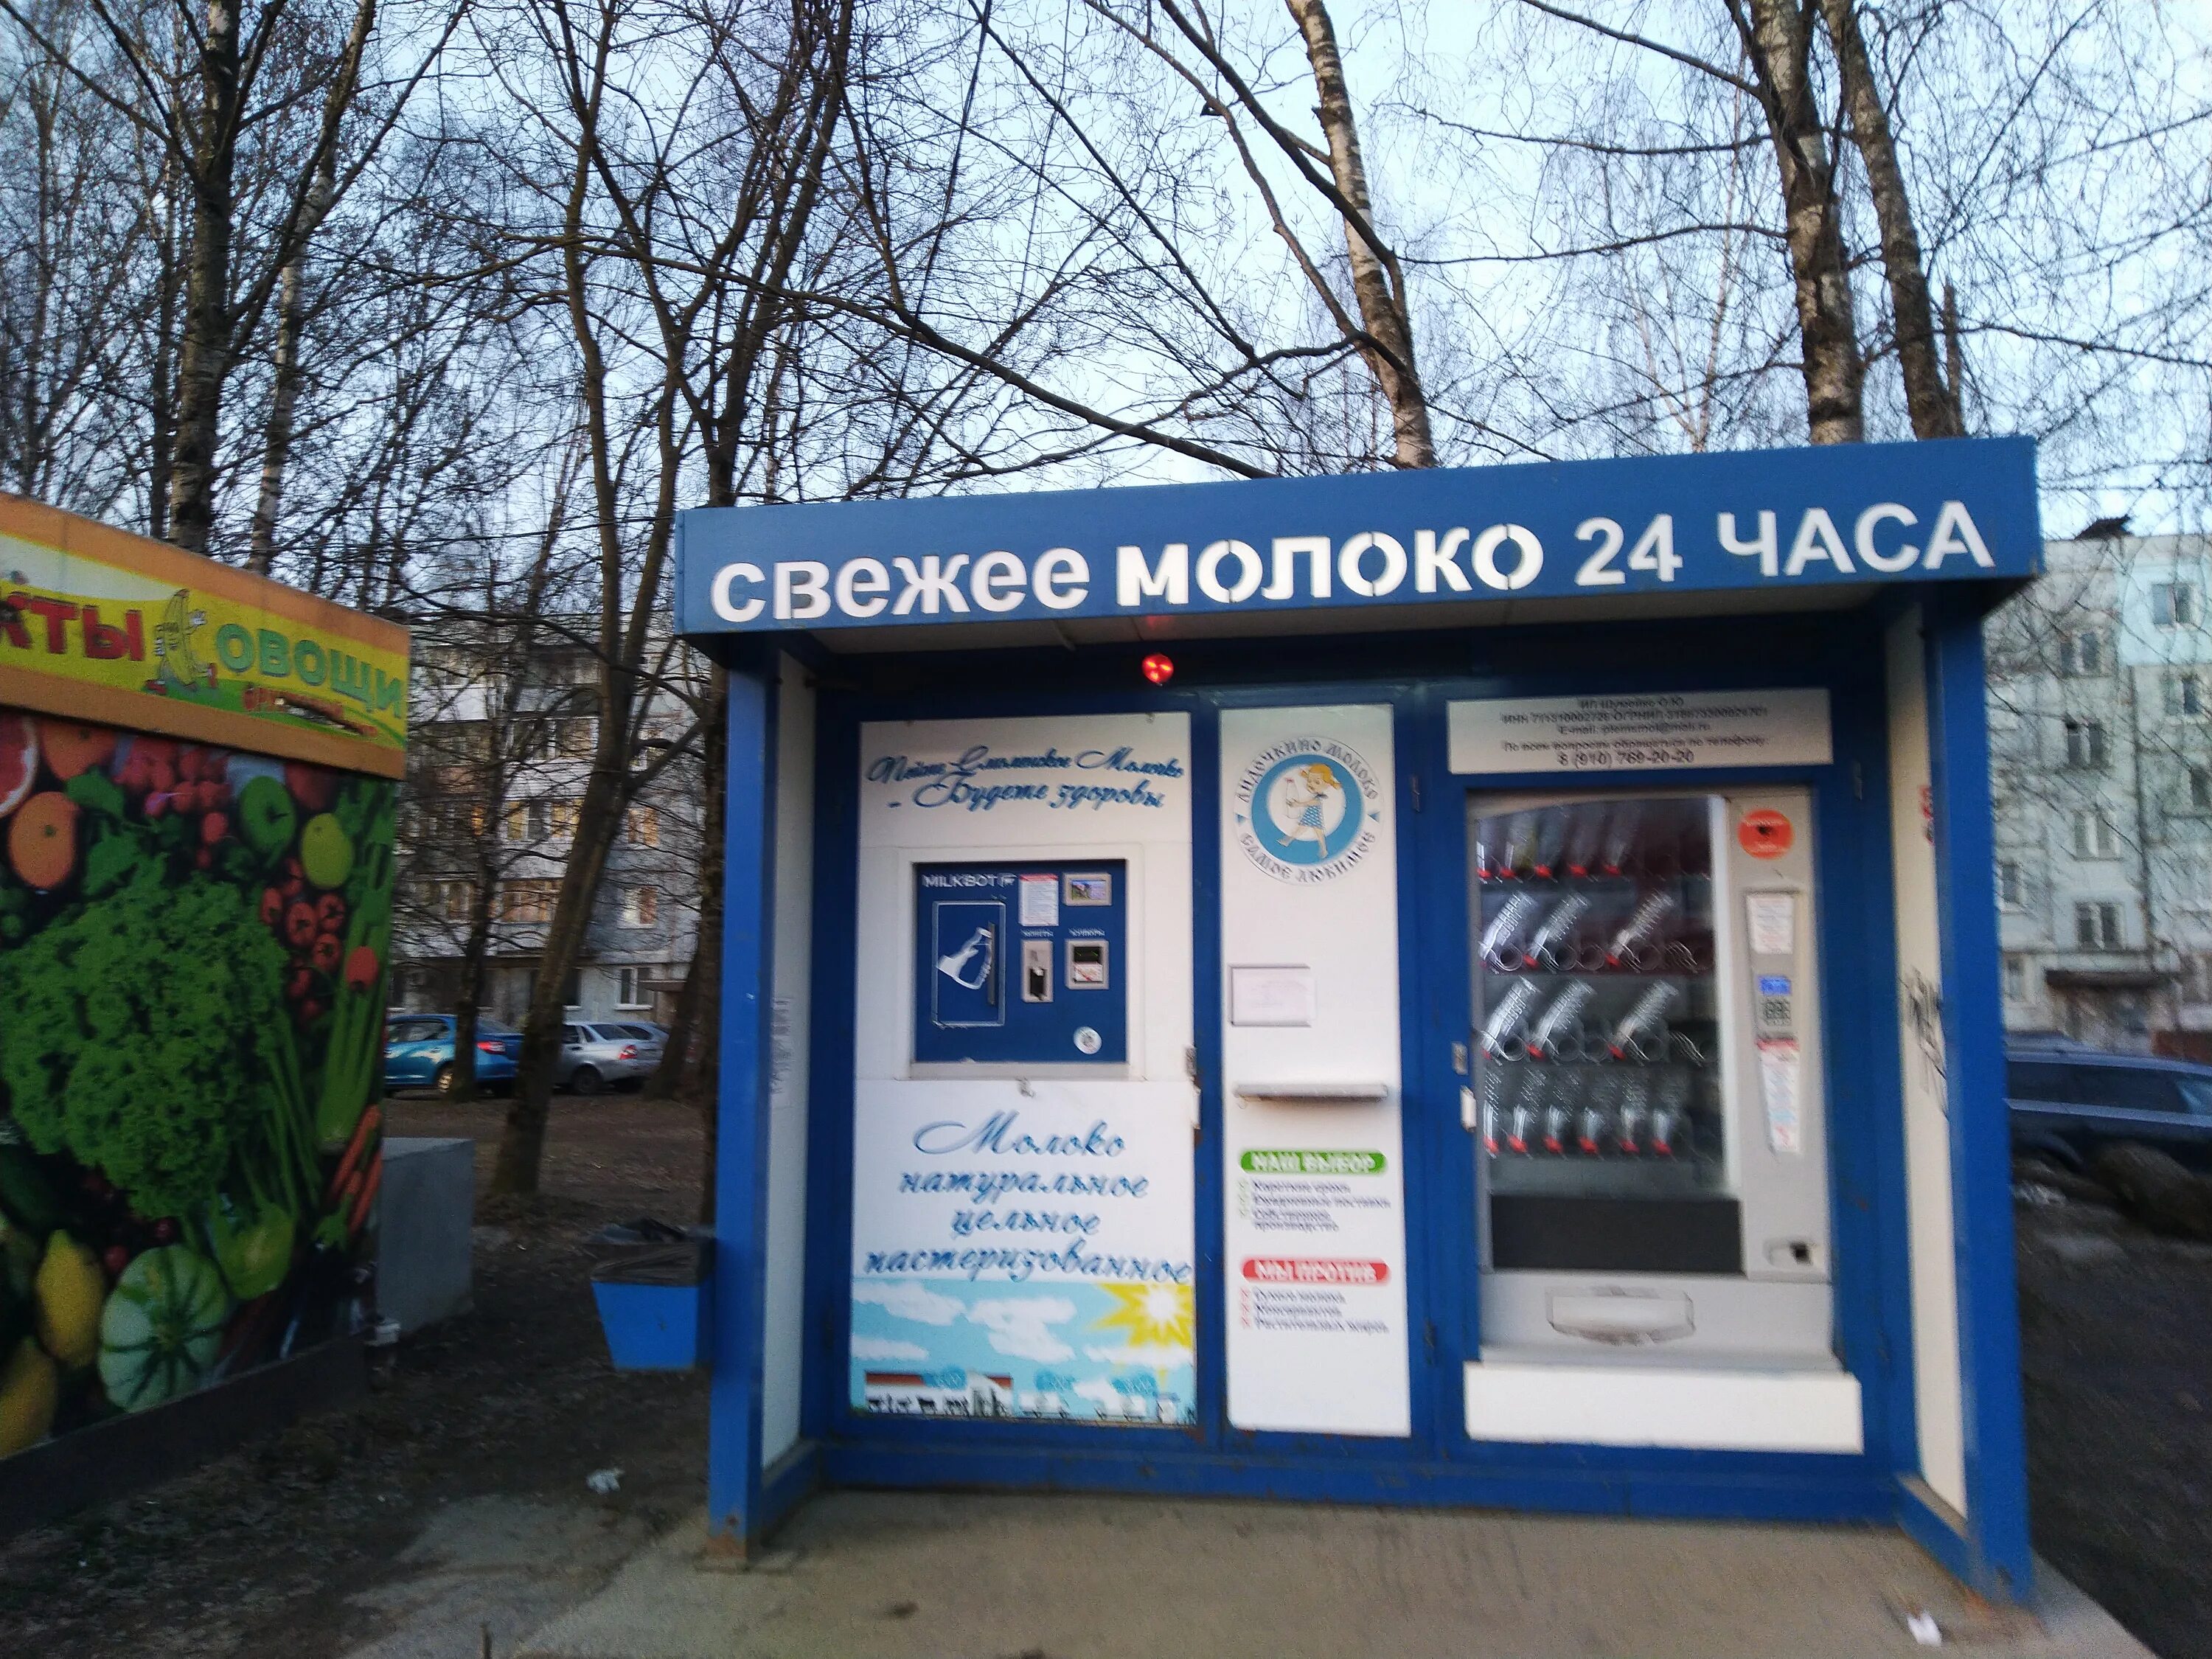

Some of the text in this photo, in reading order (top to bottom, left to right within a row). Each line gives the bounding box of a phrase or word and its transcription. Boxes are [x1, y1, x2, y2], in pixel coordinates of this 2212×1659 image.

[1575, 514, 1683, 587] 24
[1717, 500, 1994, 577] ЧАСА
[216, 623, 403, 720] ОВОЩИ
[1074, 745, 1184, 779] Молоко
[922, 873, 998, 888] MILKBOT
[913, 1110, 1127, 1157] Молоко
[898, 1171, 1150, 1204] натуральное
[950, 1208, 1101, 1240] цельное
